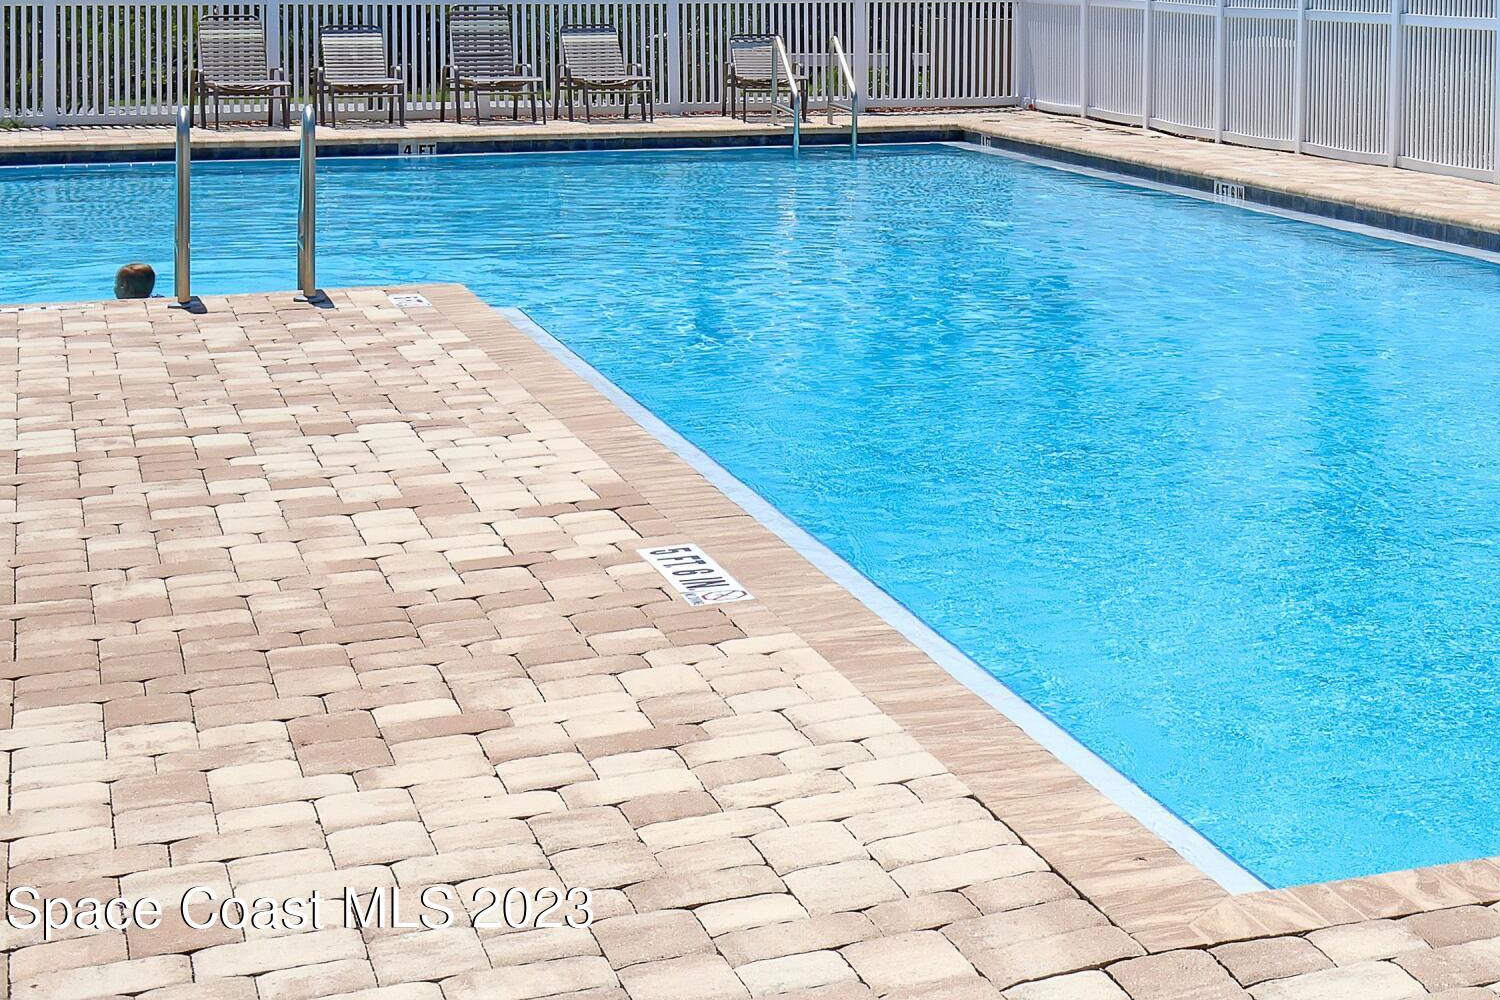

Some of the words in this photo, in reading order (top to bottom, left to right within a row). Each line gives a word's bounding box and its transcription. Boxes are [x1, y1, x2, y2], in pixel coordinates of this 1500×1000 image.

[403, 144, 412, 154] 4
[419, 144, 436, 154] FT
[1221, 184, 1229, 197] FT
[649, 546, 692, 556] 5
[671, 567, 715, 577] 6
